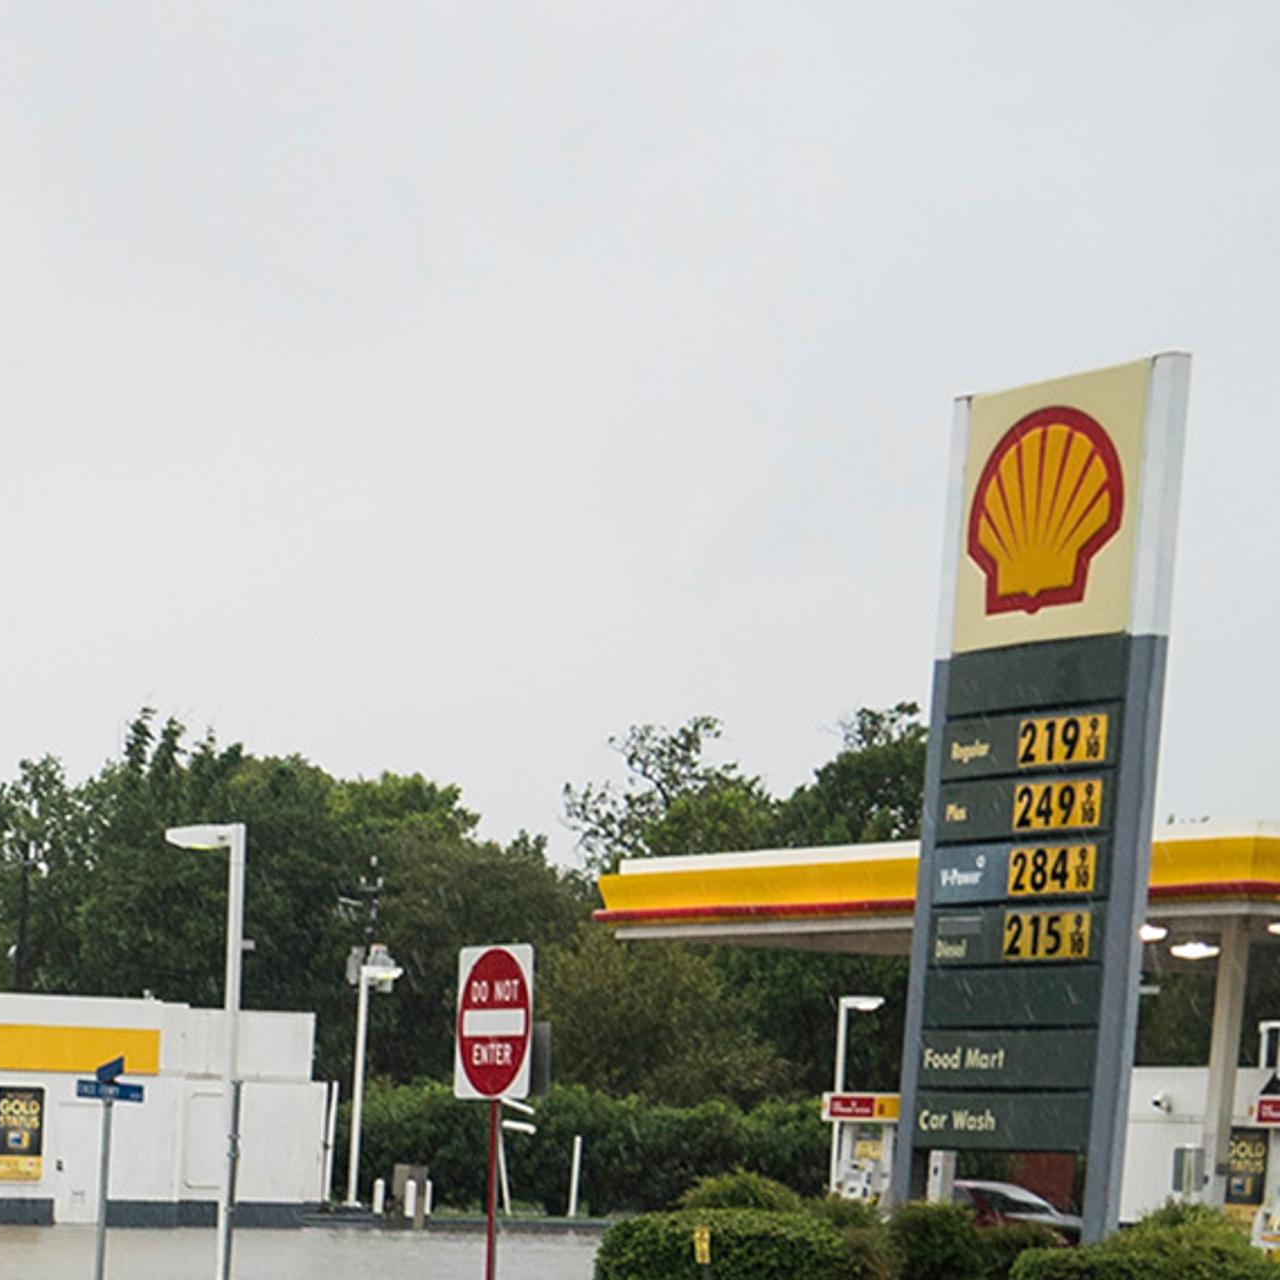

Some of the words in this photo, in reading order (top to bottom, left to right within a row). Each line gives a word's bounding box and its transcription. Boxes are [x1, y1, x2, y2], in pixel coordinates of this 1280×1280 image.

[951, 740, 989, 763] Regular
[1020, 718, 1080, 763] 219
[946, 804, 967, 821] Plus
[1016, 785, 1076, 828] 249
[1011, 849, 1069, 891] 284
[1005, 914, 1062, 956] 215
[471, 981, 488, 1003] DO
[495, 978, 520, 1003] NOT
[471, 1043, 513, 1066] ENTER
[924, 1046, 961, 1069] Food
[965, 1047, 1004, 1069] Mart
[0, 1099, 40, 1115] GOLD
[919, 1109, 948, 1131] Car
[951, 1109, 996, 1131] Wash
